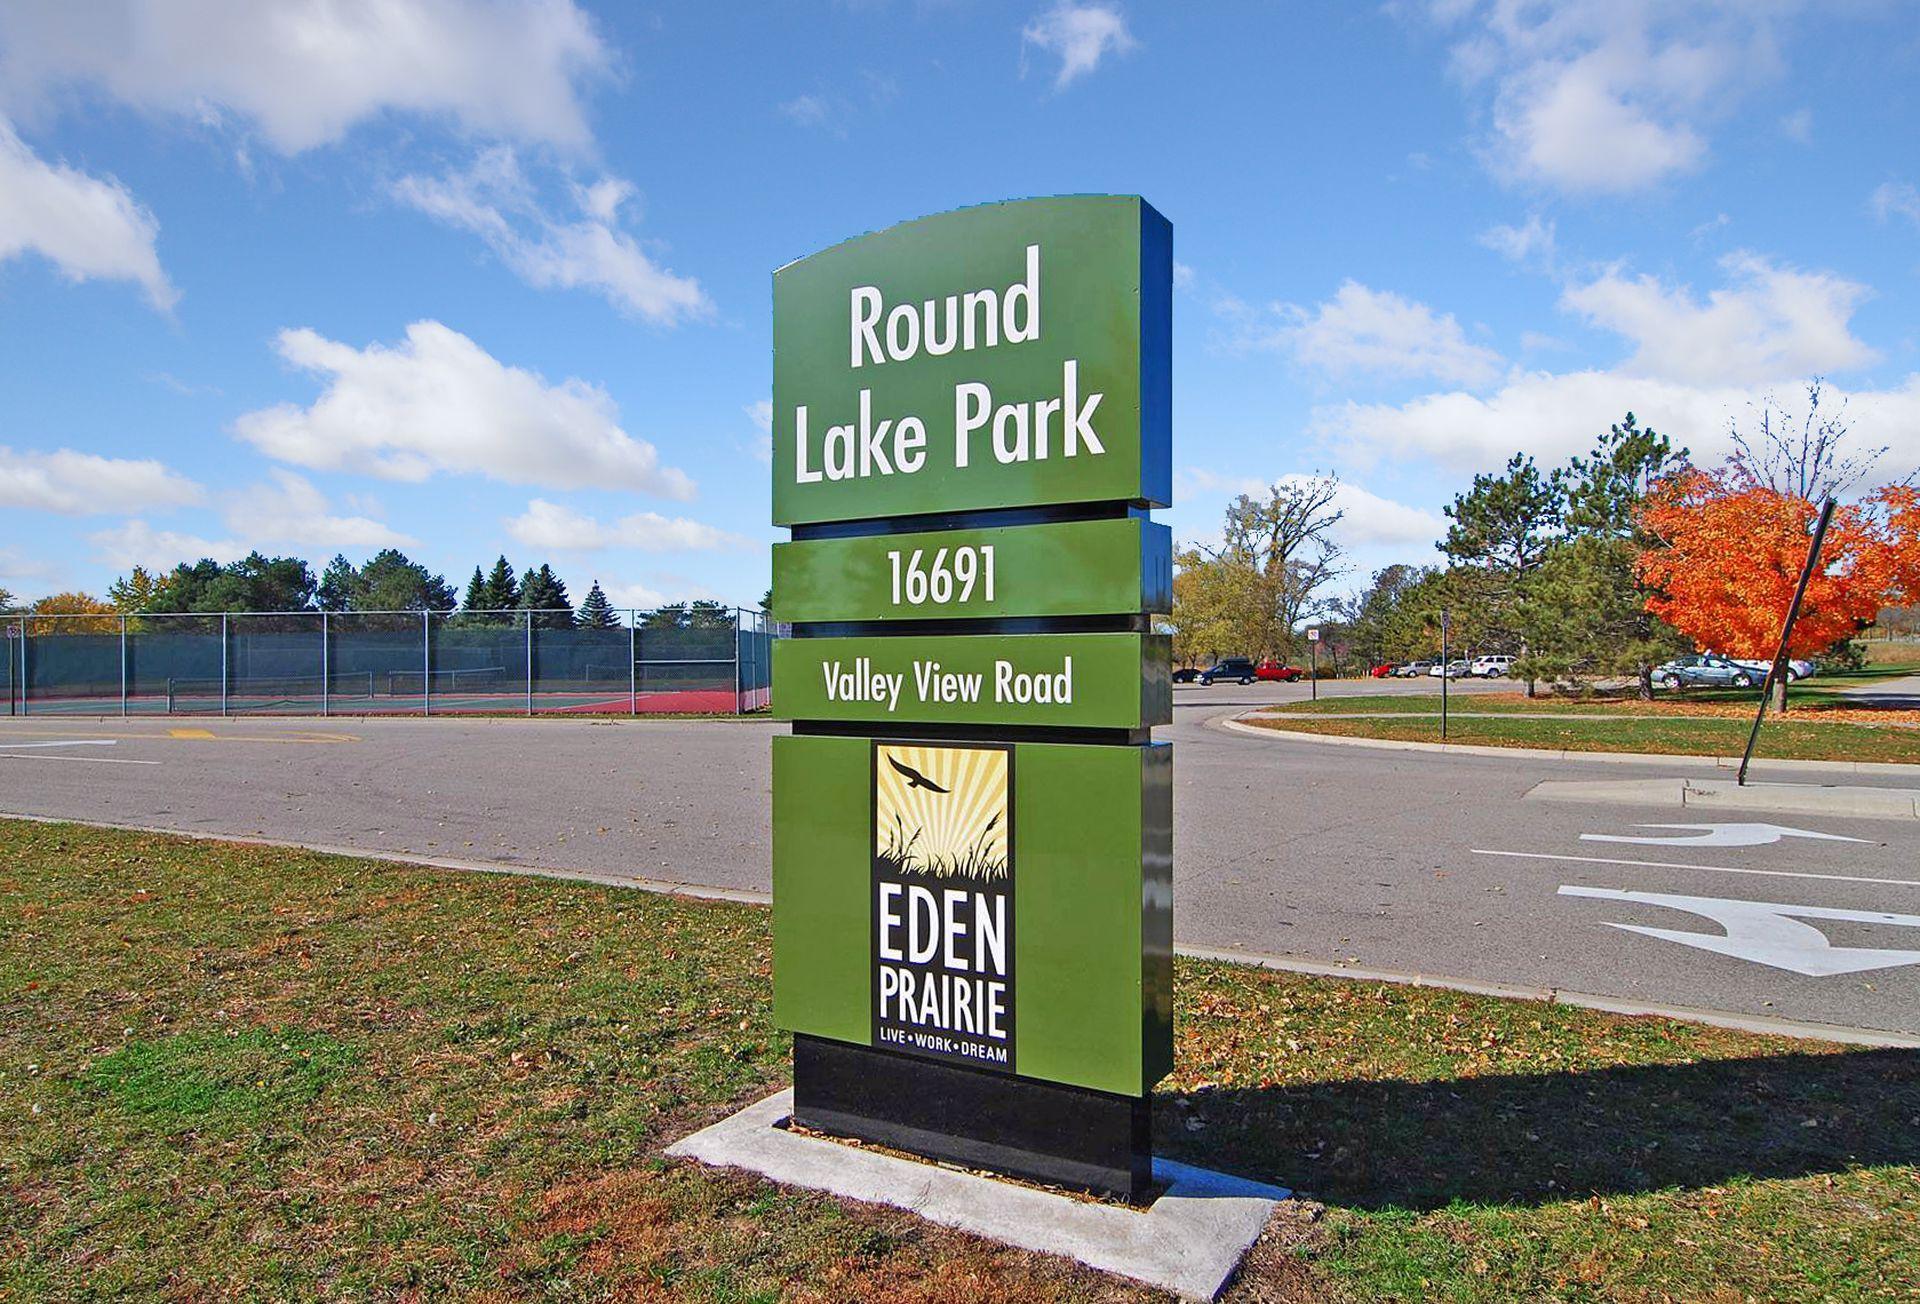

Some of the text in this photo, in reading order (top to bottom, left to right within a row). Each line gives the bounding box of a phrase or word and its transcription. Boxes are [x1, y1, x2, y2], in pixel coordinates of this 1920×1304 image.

[851, 244, 1040, 367] Round
[796, 359, 1106, 484] Lake Park
[888, 545, 995, 605] 16691
[822, 655, 1073, 712] Valley View Road
[879, 882, 1006, 976] EDEN
[879, 965, 1007, 1039] PRAIRIE
[880, 1027, 1008, 1063] LIVE WORK DREAM
